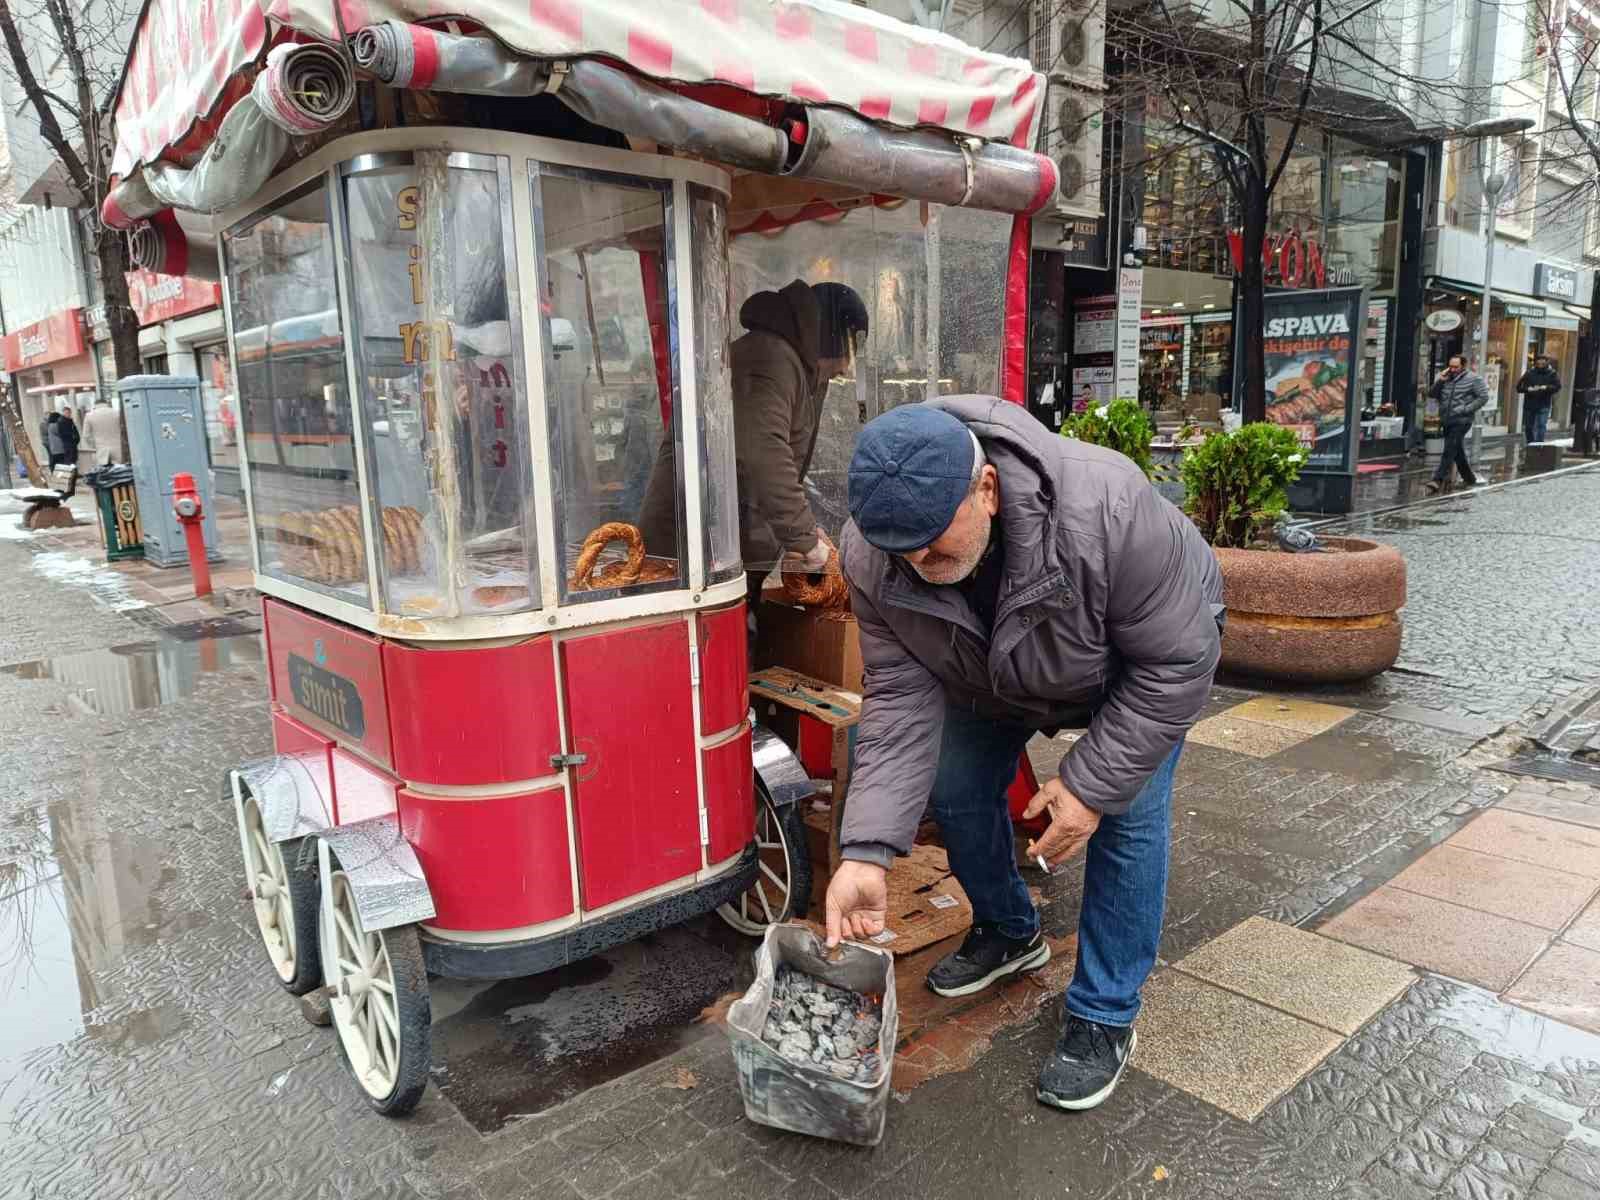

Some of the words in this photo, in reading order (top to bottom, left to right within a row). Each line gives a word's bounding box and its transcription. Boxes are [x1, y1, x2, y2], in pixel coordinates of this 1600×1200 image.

[1329, 267, 1352, 284] avm
[1328, 335, 1349, 350] de
[301, 665, 350, 731] simit
